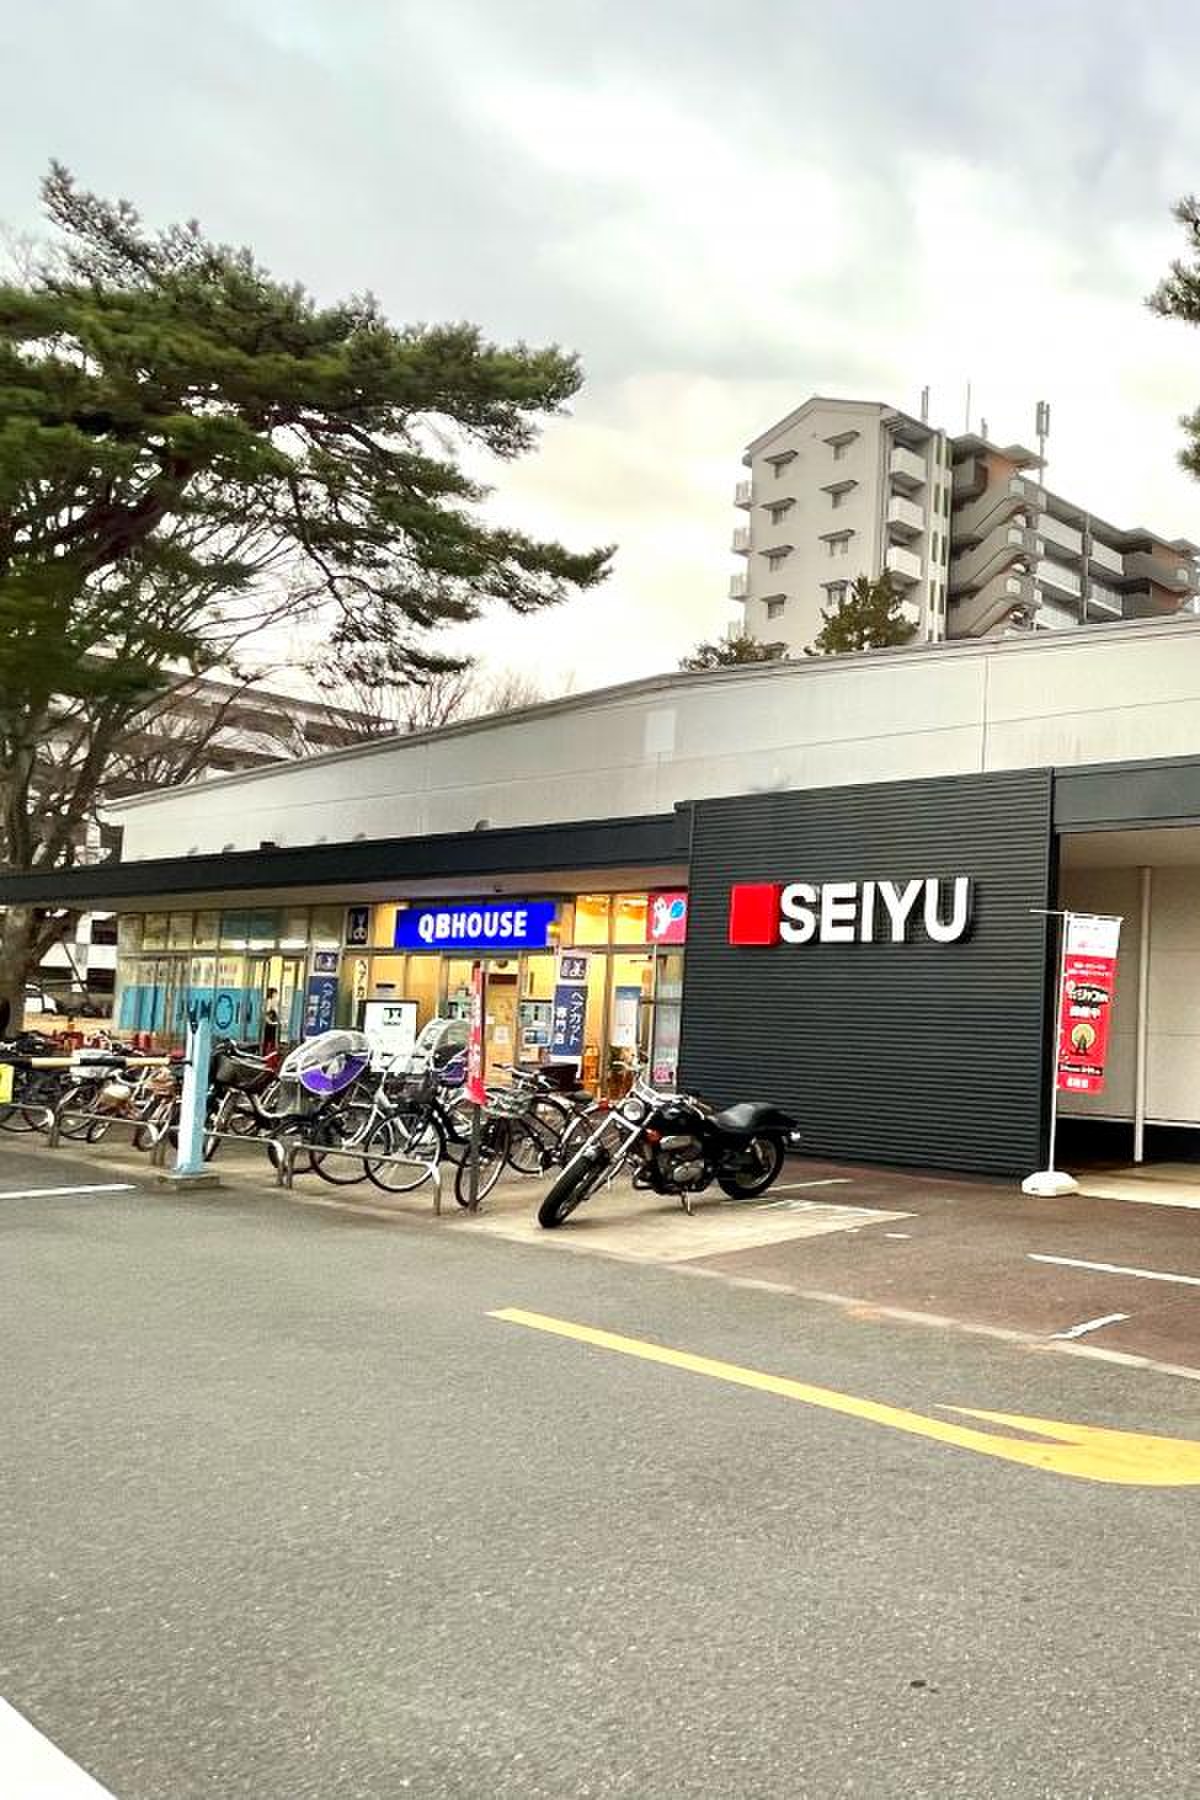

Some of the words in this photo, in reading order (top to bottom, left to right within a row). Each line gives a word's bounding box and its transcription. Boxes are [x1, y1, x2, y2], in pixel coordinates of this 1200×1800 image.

[418, 911, 528, 943] QBHOUSE
[779, 877, 969, 943] SEIYU
[569, 991, 585, 1046] ヘアカット
